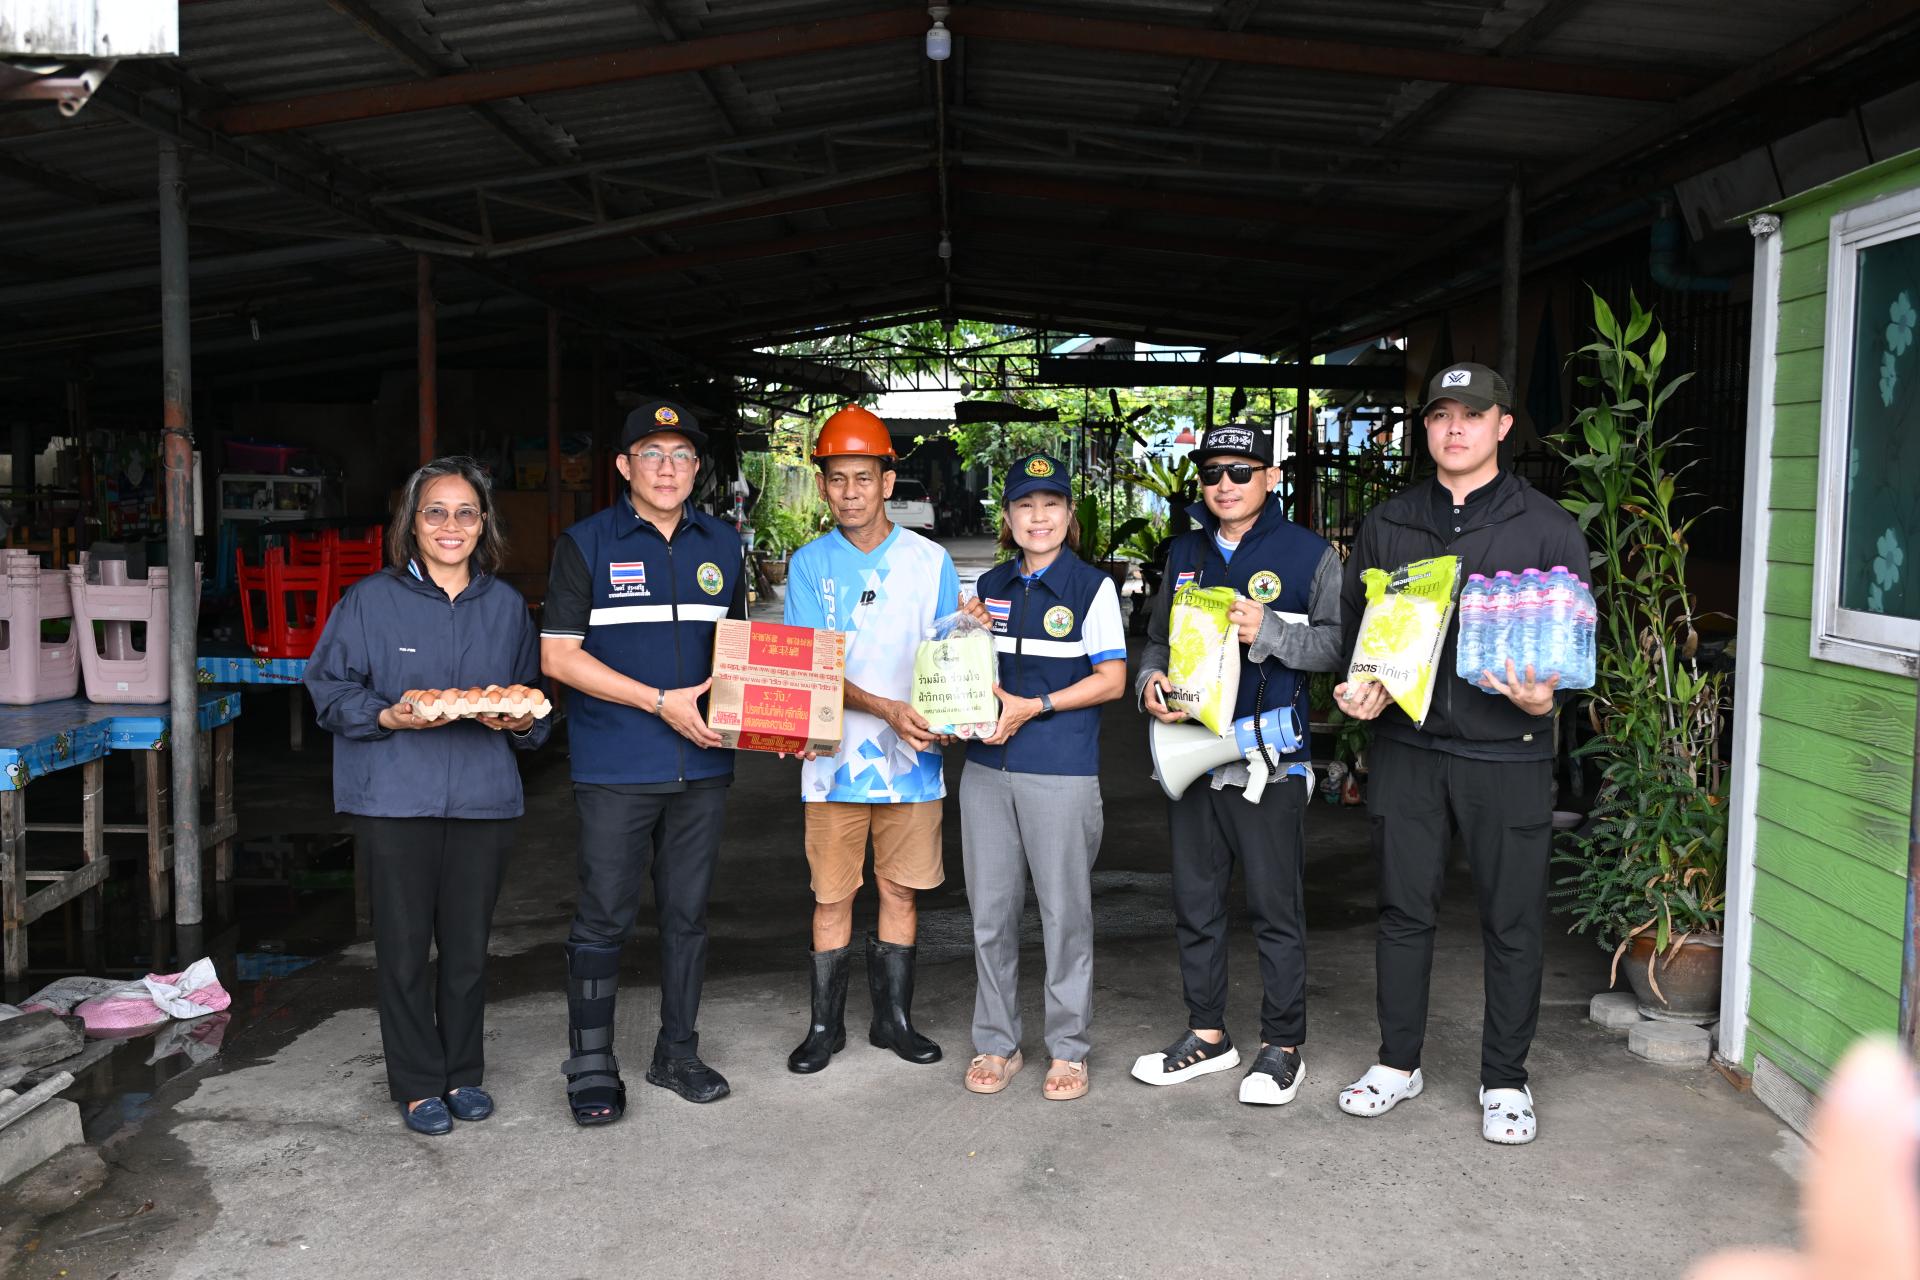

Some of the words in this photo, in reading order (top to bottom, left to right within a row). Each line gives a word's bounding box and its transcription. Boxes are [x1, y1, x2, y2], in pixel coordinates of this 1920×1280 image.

[860, 590, 877, 603] ID
[918, 672, 946, 685] ร่วมมือ
